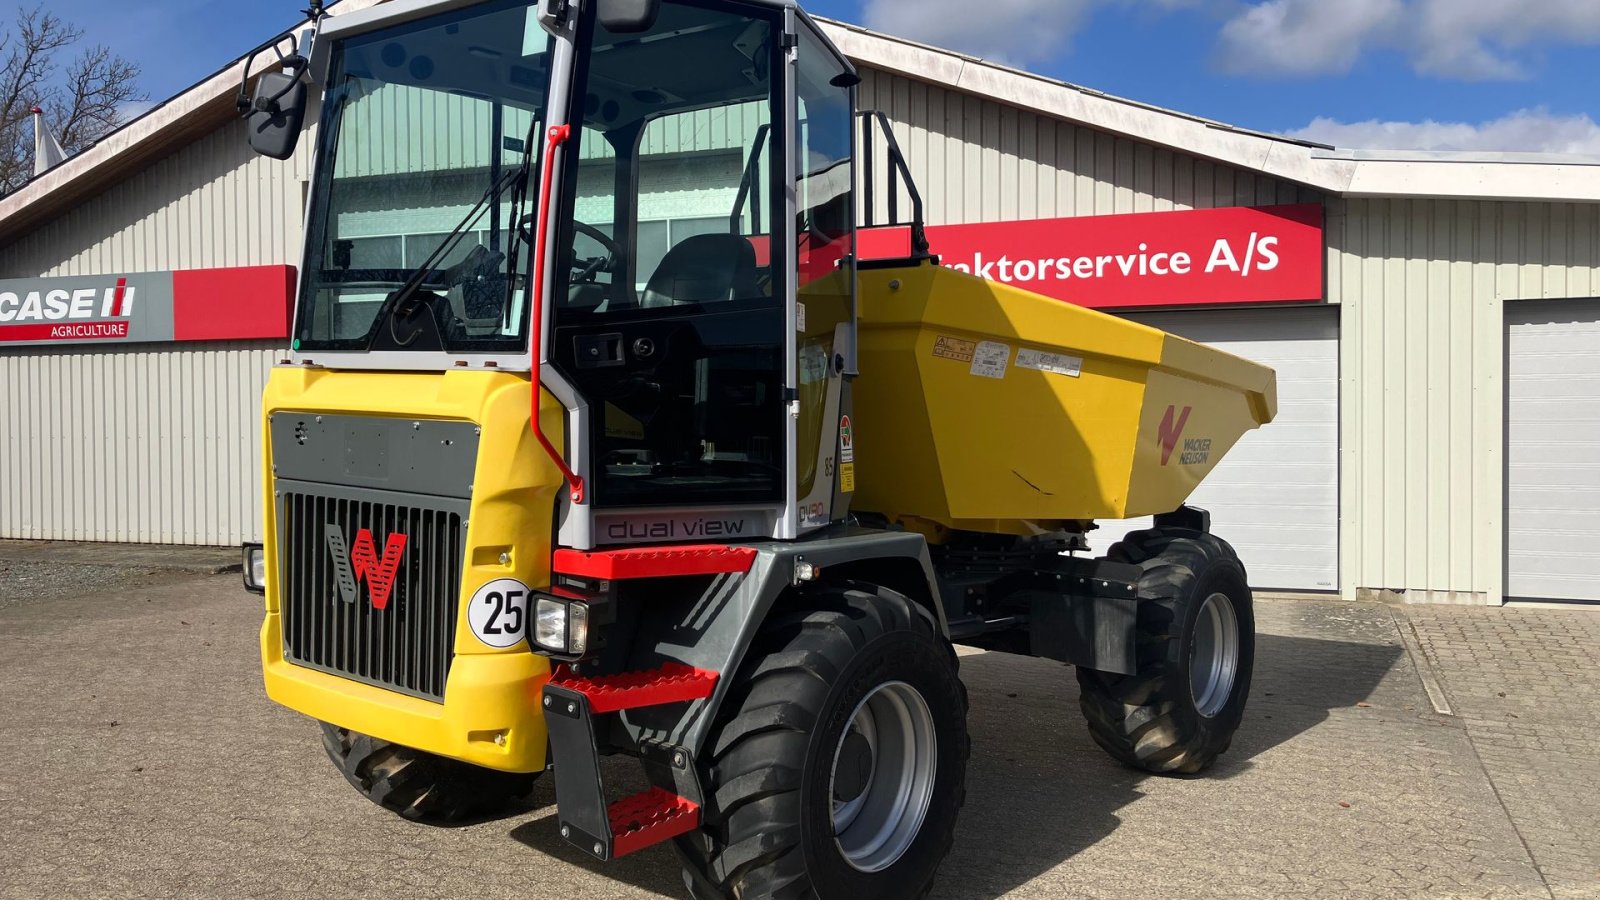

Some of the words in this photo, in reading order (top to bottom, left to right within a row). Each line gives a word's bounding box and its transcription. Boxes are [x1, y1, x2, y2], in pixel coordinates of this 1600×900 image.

[938, 242, 1191, 282] aktorservice
[1204, 231, 1279, 277] A/S
[0, 289, 96, 321] CASE
[51, 323, 125, 338] AGRICULTURE
[1184, 439, 1211, 451] WACKER
[1179, 452, 1208, 464] NEUSON
[608, 520, 674, 539] dual
[683, 518, 744, 536] view
[483, 590, 523, 635] 25
